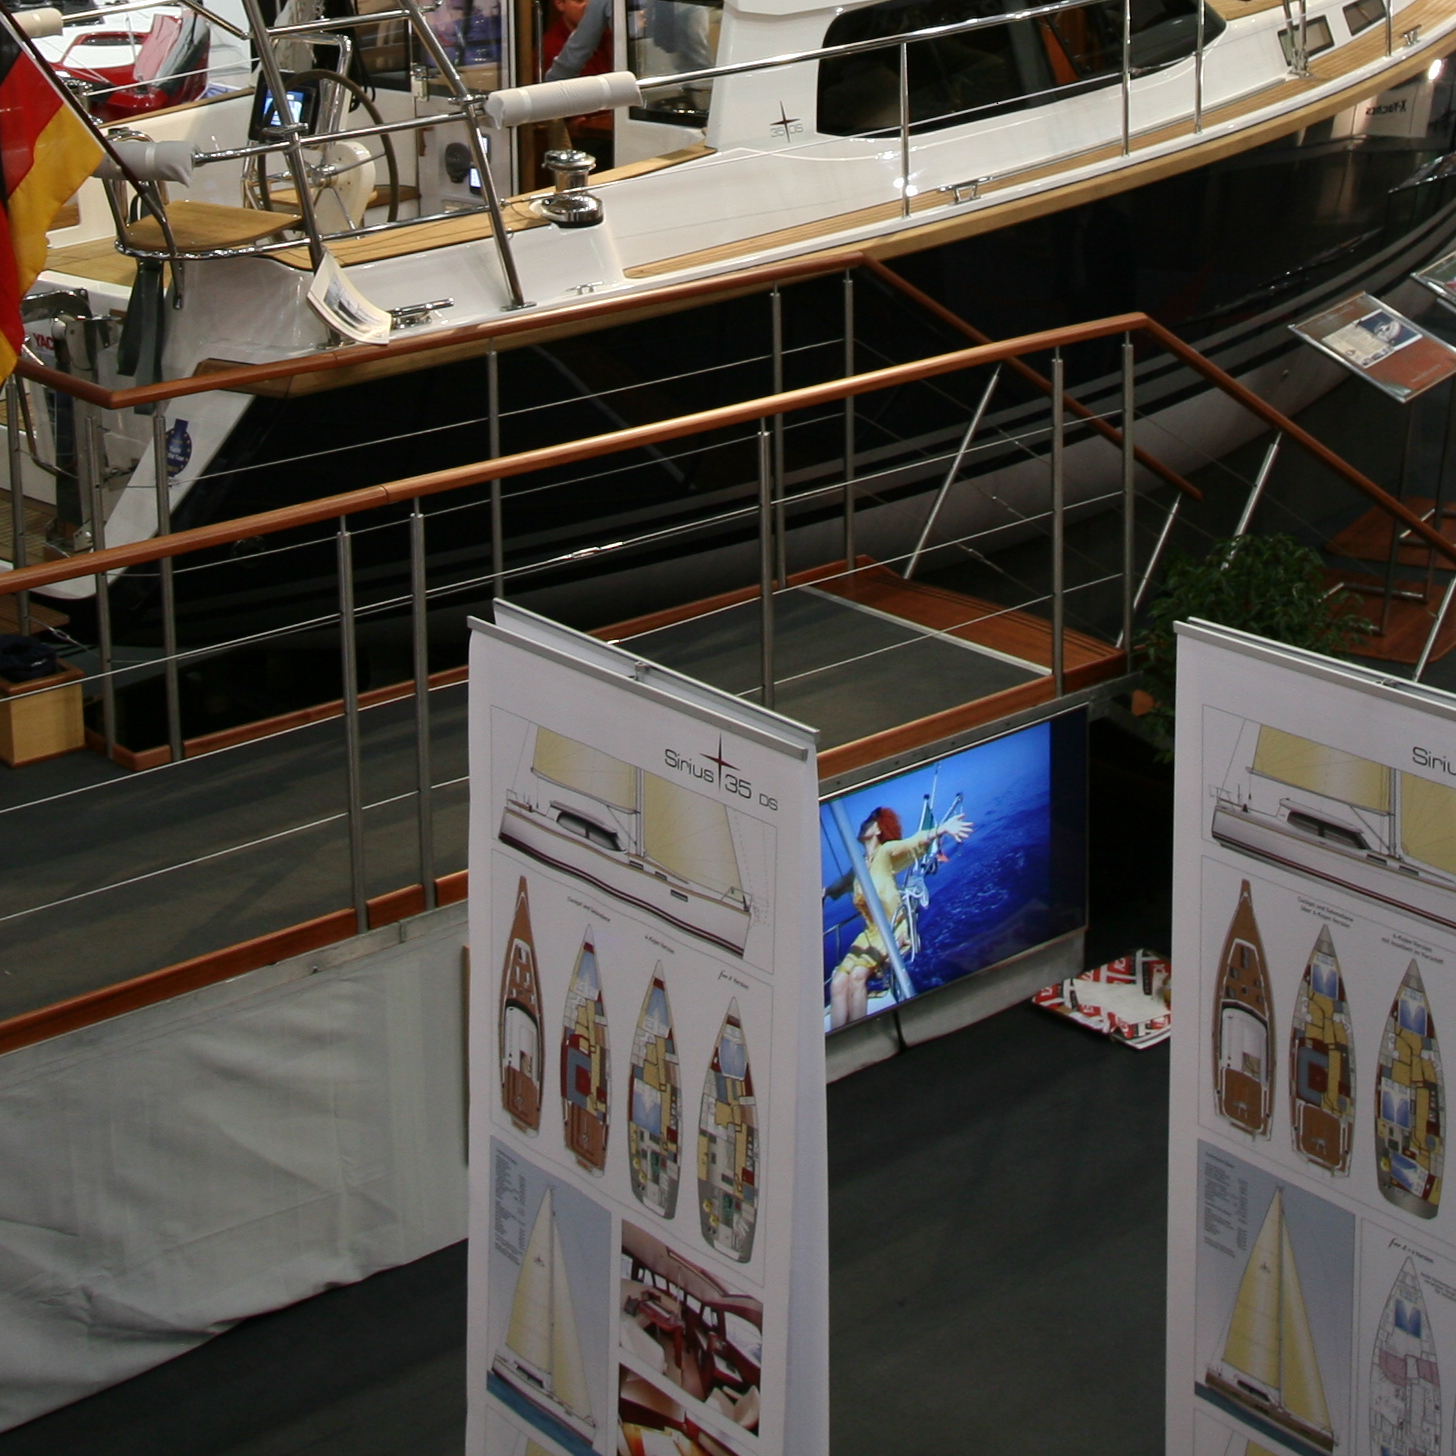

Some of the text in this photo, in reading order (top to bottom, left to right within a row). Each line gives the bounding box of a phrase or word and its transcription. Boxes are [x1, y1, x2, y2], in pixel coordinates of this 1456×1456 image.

[664, 748, 779, 811] Sirius 35 DS
